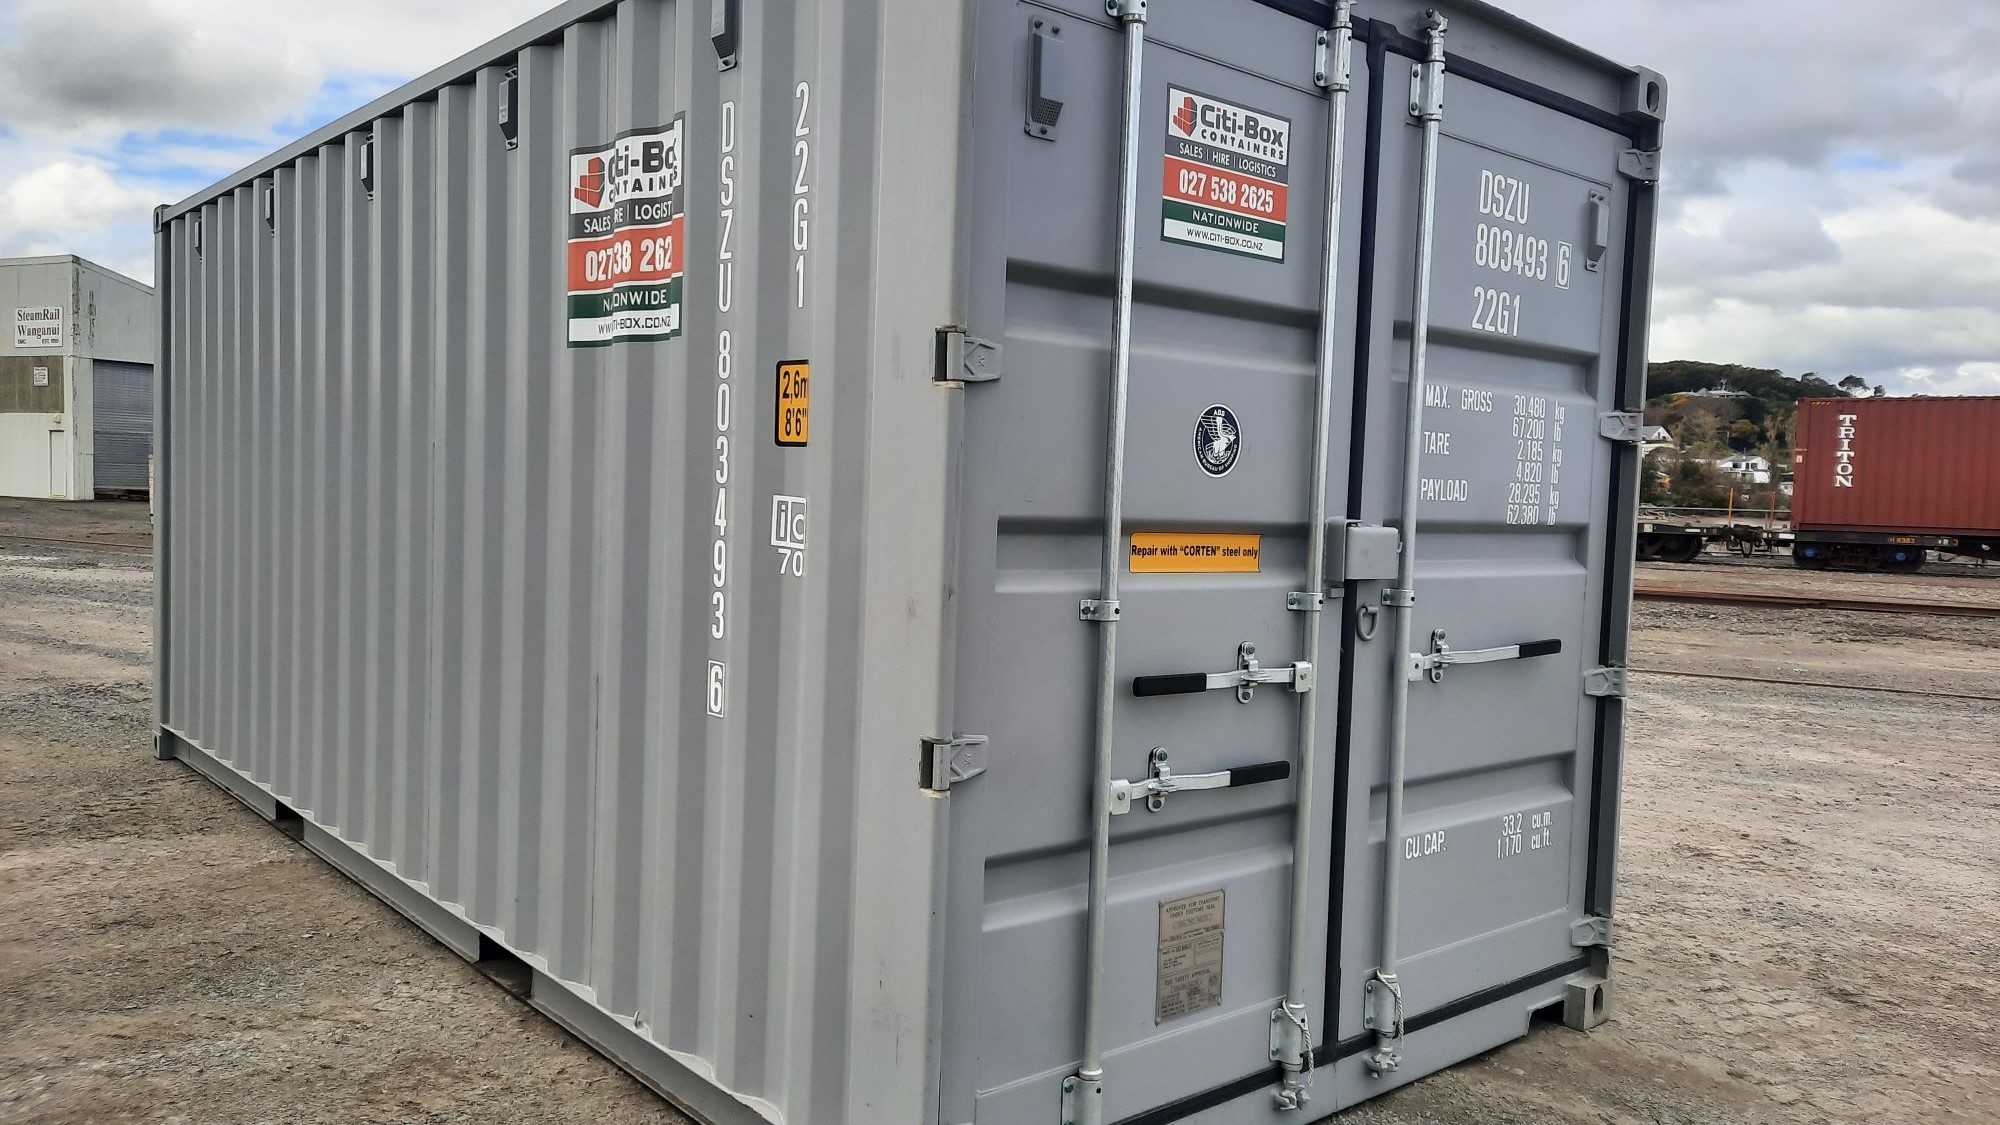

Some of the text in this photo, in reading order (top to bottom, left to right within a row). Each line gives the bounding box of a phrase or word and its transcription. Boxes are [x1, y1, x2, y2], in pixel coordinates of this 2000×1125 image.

[1201, 104, 1284, 147] Citi-Box
[1201, 129, 1284, 160] CONTAINERS
[1179, 143, 1277, 178] SALES HIRE LOGISTICS
[793, 81, 810, 308] 22G1
[1179, 168, 1275, 213] 027 538 2625
[1479, 169, 1530, 224] DSZU
[584, 214, 612, 233] SALES
[1192, 209, 1260, 234] NATIONWIDE
[1186, 227, 1263, 251] WWW.CITI-BOX.CO.NZ
[1475, 222, 1570, 287] 803493 6
[17, 309, 60, 321] SteamRail
[1471, 285, 1521, 337] 22G1
[17, 323, 60, 340] Wanganui
[709, 101, 735, 715] DSZU 803493 6
[1425, 384, 1450, 409] MAX.
[1461, 388, 1493, 413] GROSS
[1554, 400, 1565, 424] kg
[1553, 422, 1562, 442] lb
[1424, 431, 1450, 455] TARE
[1552, 443, 1563, 467] kg
[1835, 414, 1857, 487] TRITON
[1550, 464, 1559, 484] lb
[1420, 479, 1468, 502] PAYLOAD
[1549, 485, 1560, 510] kg
[1546, 505, 1556, 526] lb
[778, 548, 804, 577] 70
[1131, 545, 1158, 559] Repair
[1160, 545, 1178, 556] with
[1222, 547, 1241, 556] steel
[1242, 546, 1258, 559] only
[1503, 813, 1523, 836] 33.2
